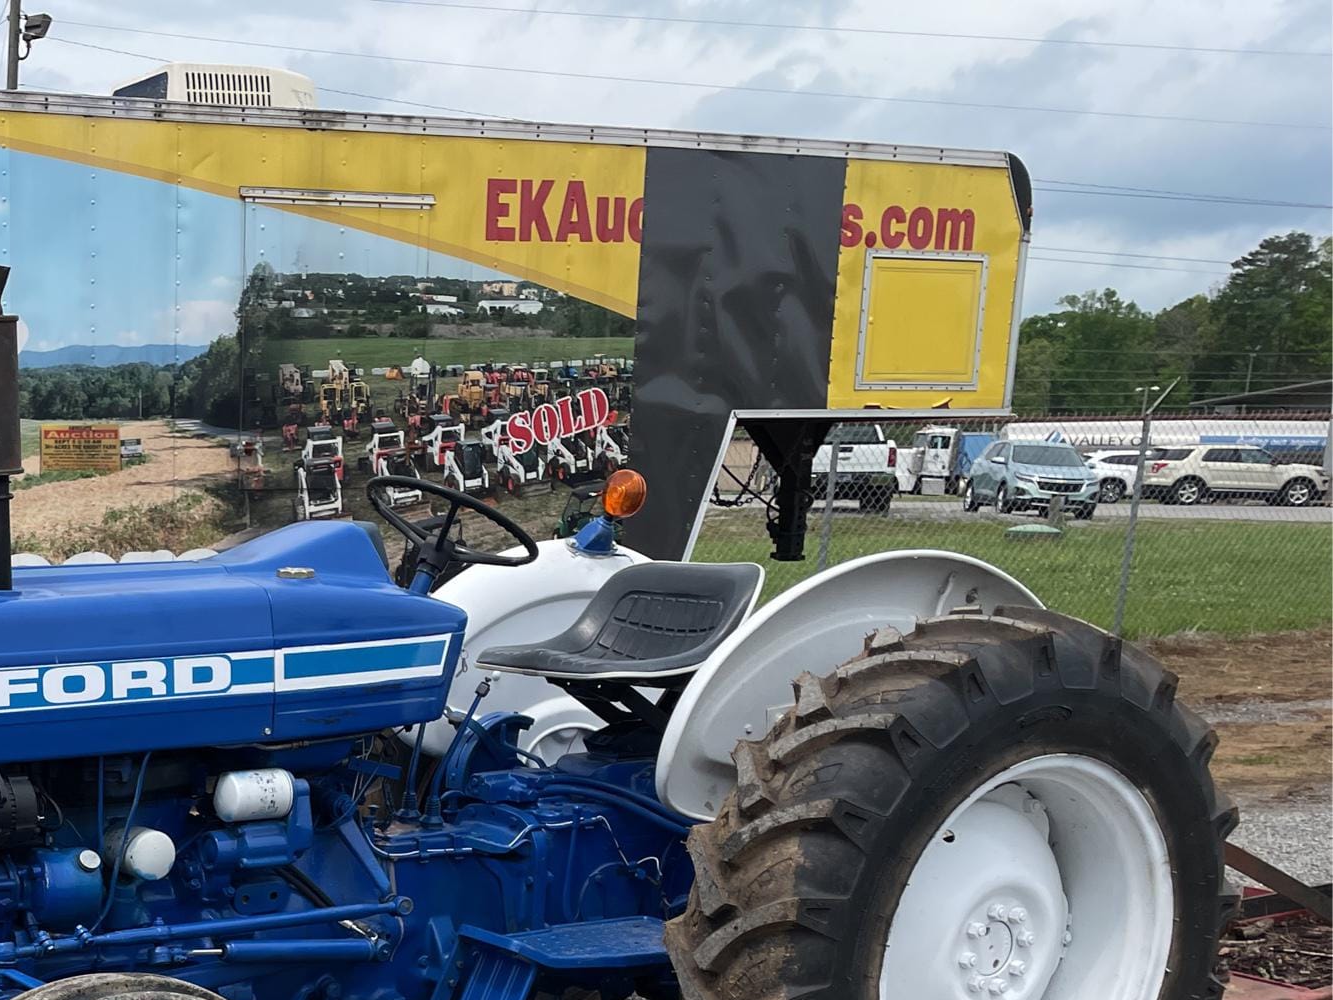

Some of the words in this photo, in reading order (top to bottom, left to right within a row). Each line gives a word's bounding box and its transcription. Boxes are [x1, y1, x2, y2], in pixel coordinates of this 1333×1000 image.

[507, 388, 609, 456] SOLD
[46, 430, 116, 439] Auction
[1069, 436, 1124, 446] VALLEY
[1130, 436, 1157, 446] OL
